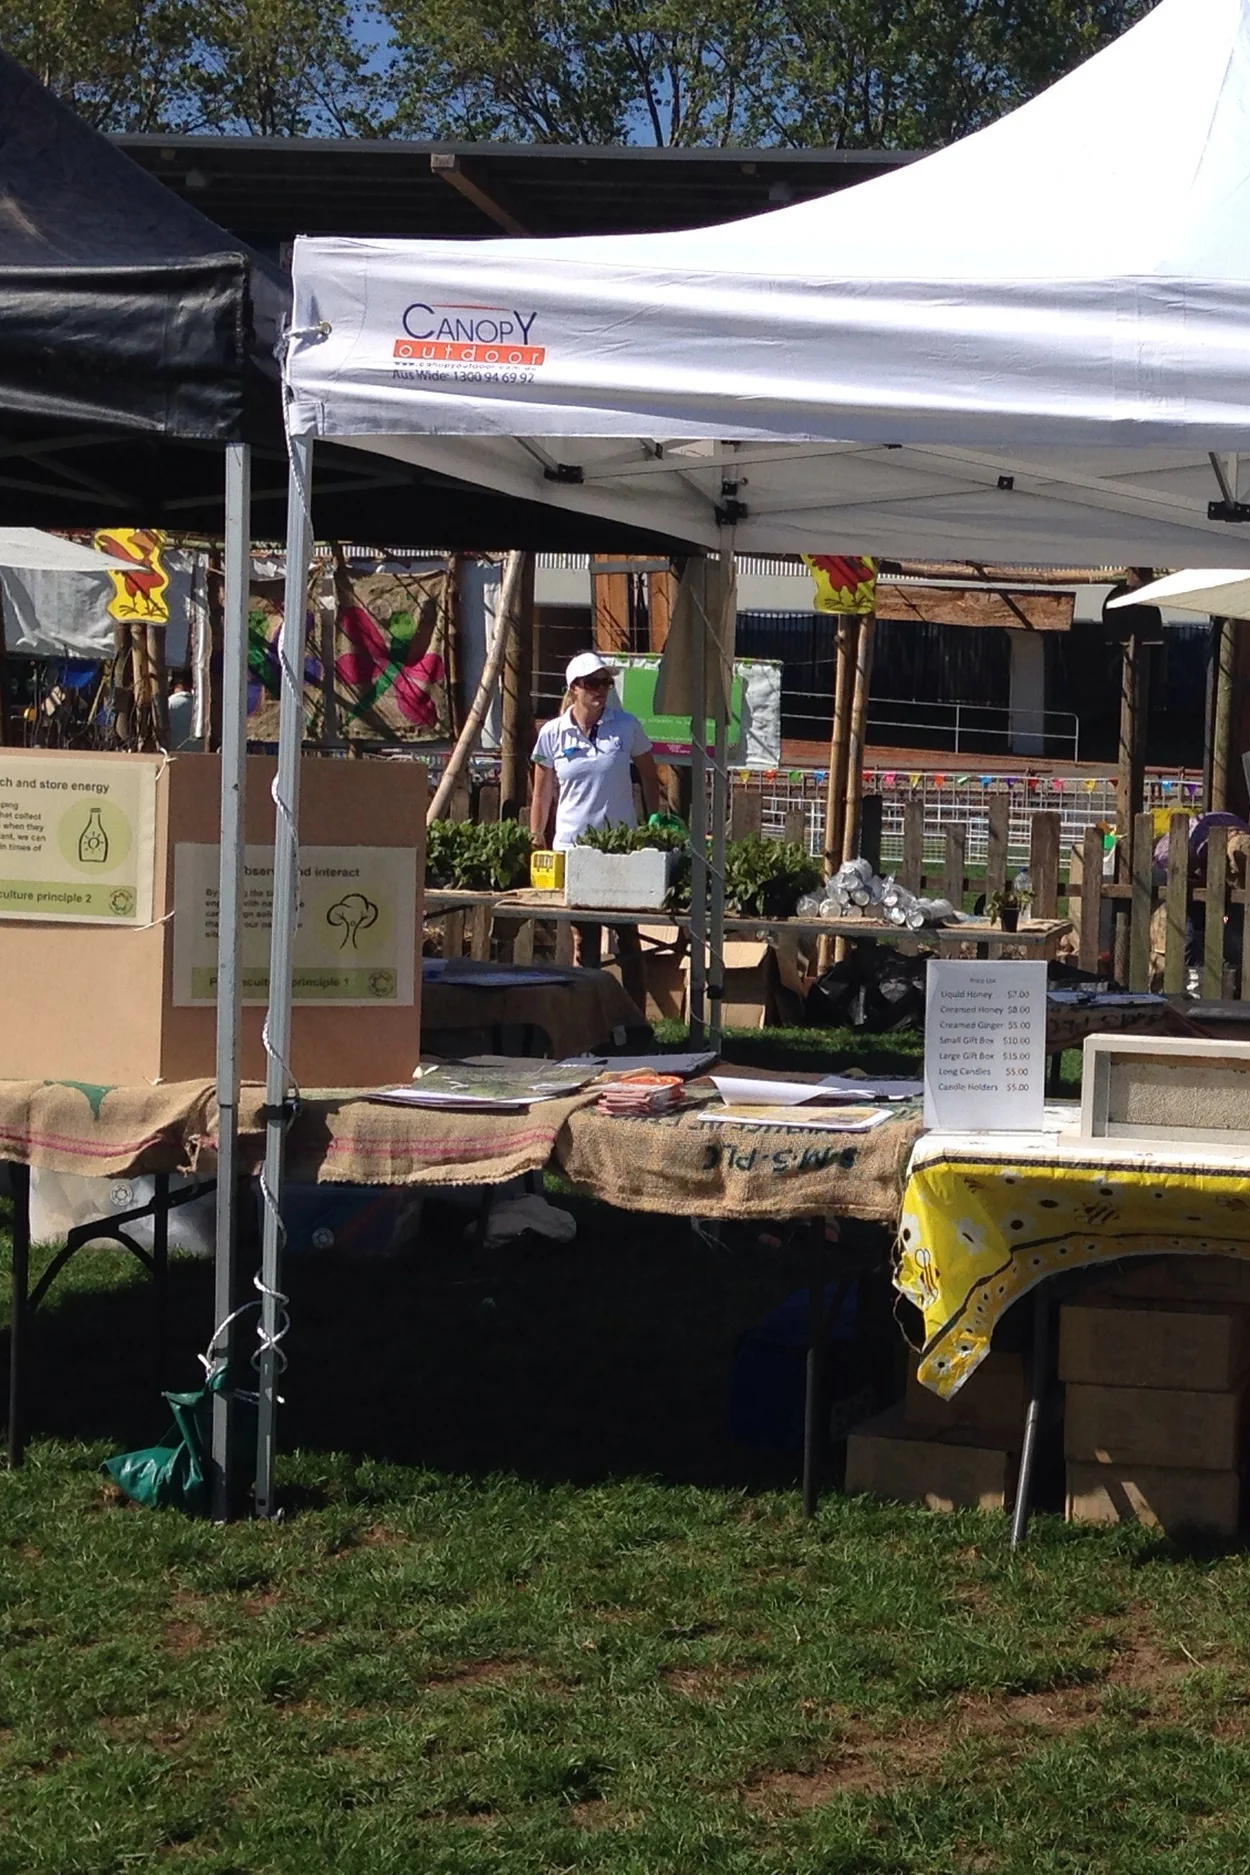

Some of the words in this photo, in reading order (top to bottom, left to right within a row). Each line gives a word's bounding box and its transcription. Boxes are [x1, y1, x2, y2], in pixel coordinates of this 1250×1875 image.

[402, 303, 537, 345] CANOPY
[398, 344, 541, 365] outdoor
[392, 369, 414, 381] Aus
[454, 371, 482, 382] 1300
[483, 371, 499, 383] 94
[503, 372, 517, 383] 69
[520, 372, 534, 384] 92
[16, 779, 36, 789] and
[40, 780, 68, 790] store
[71, 782, 109, 794] energy
[15, 813, 41, 821] collect
[3, 823, 25, 831] when
[27, 823, 44, 833] they
[9, 844, 31, 852] times
[315, 867, 360, 878] interact
[37, 892, 82, 904] principle
[86, 894, 92, 904] 2
[292, 977, 340, 989] principle
[941, 991, 965, 1000] Liquid
[967, 991, 993, 1000] Honey
[940, 1005, 976, 1014] Creamed
[978, 1006, 1004, 1015] Honey
[939, 1021, 976, 1029] Creamed
[977, 1021, 1004, 1031] Ginger
[939, 1036, 962, 1045] Small
[963, 1036, 978, 1045] Gift
[979, 1036, 994, 1045] Box
[1003, 1037, 1031, 1045] $10.00
[939, 1052, 961, 1061] Large
[963, 1051, 978, 1060] Gift
[979, 1052, 994, 1060] Box
[1003, 1052, 1031, 1061] $15.00
[938, 1067, 958, 1076] Long
[959, 1067, 991, 1076] Candles
[938, 1083, 966, 1091] Candle
[967, 1083, 998, 1091] Holders
